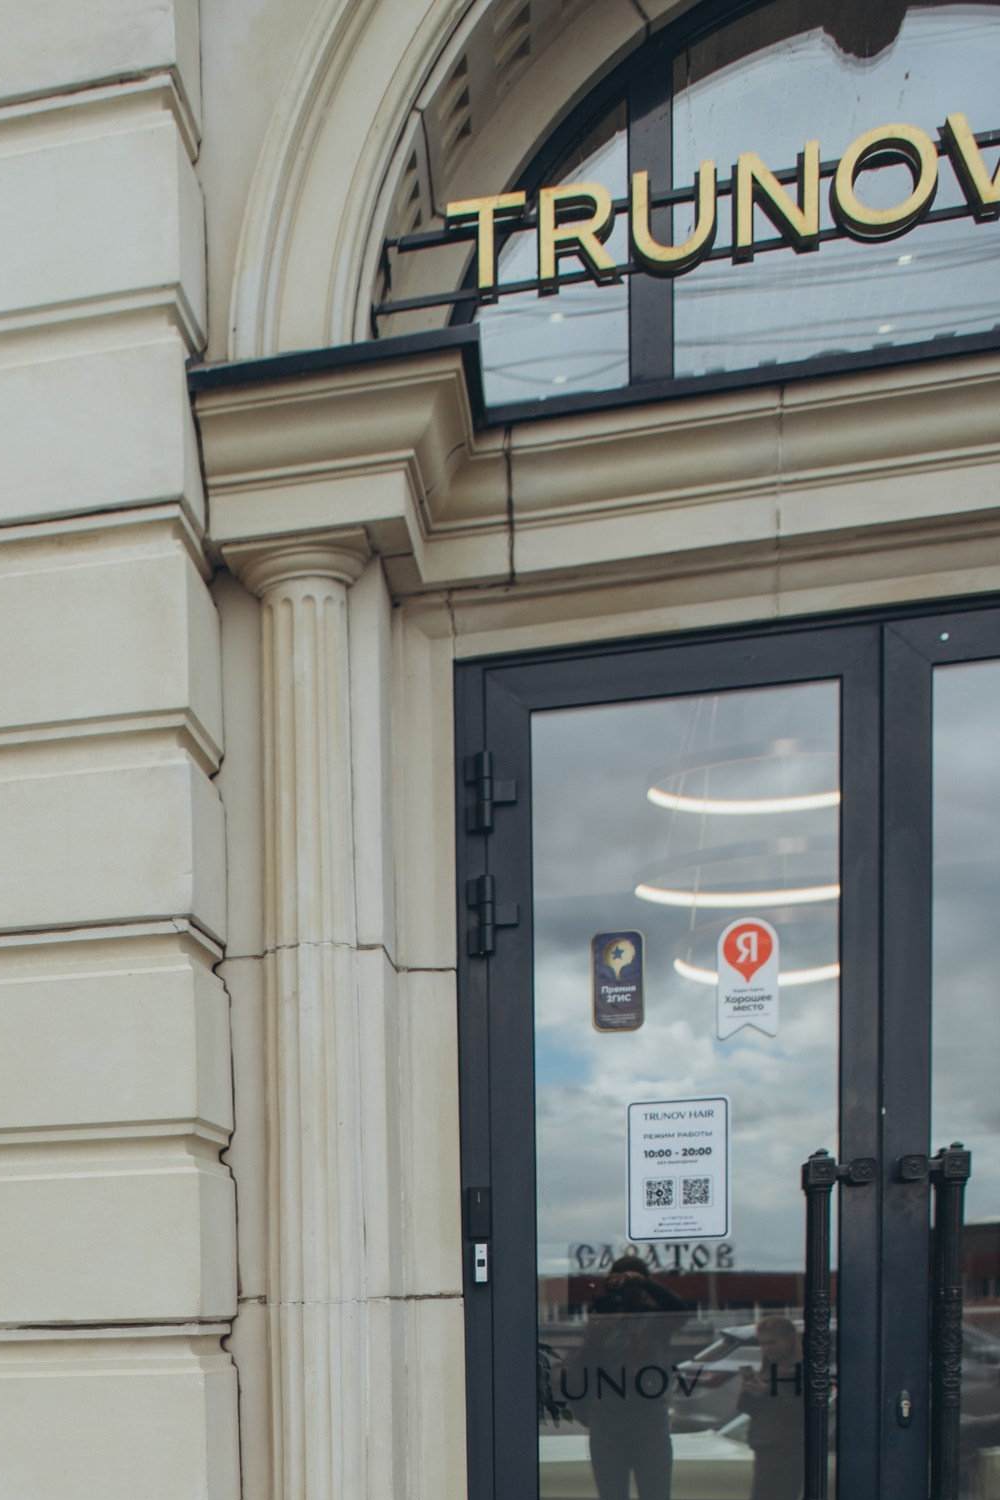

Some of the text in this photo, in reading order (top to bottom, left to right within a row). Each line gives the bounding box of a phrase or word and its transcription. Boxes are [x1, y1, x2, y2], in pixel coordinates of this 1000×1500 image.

[446, 112, 1000, 294] TRUNOV
[601, 985, 637, 995] Премия
[606, 993, 632, 1003] 2ГИС
[724, 994, 773, 1004] Хорошее
[732, 1003, 764, 1011] место
[643, 1109, 714, 1122] TRUNOV HAIR
[643, 1132, 675, 1140] РЕЖИМ
[643, 1149, 672, 1159] 10:00
[681, 1147, 712, 1157] 20:00
